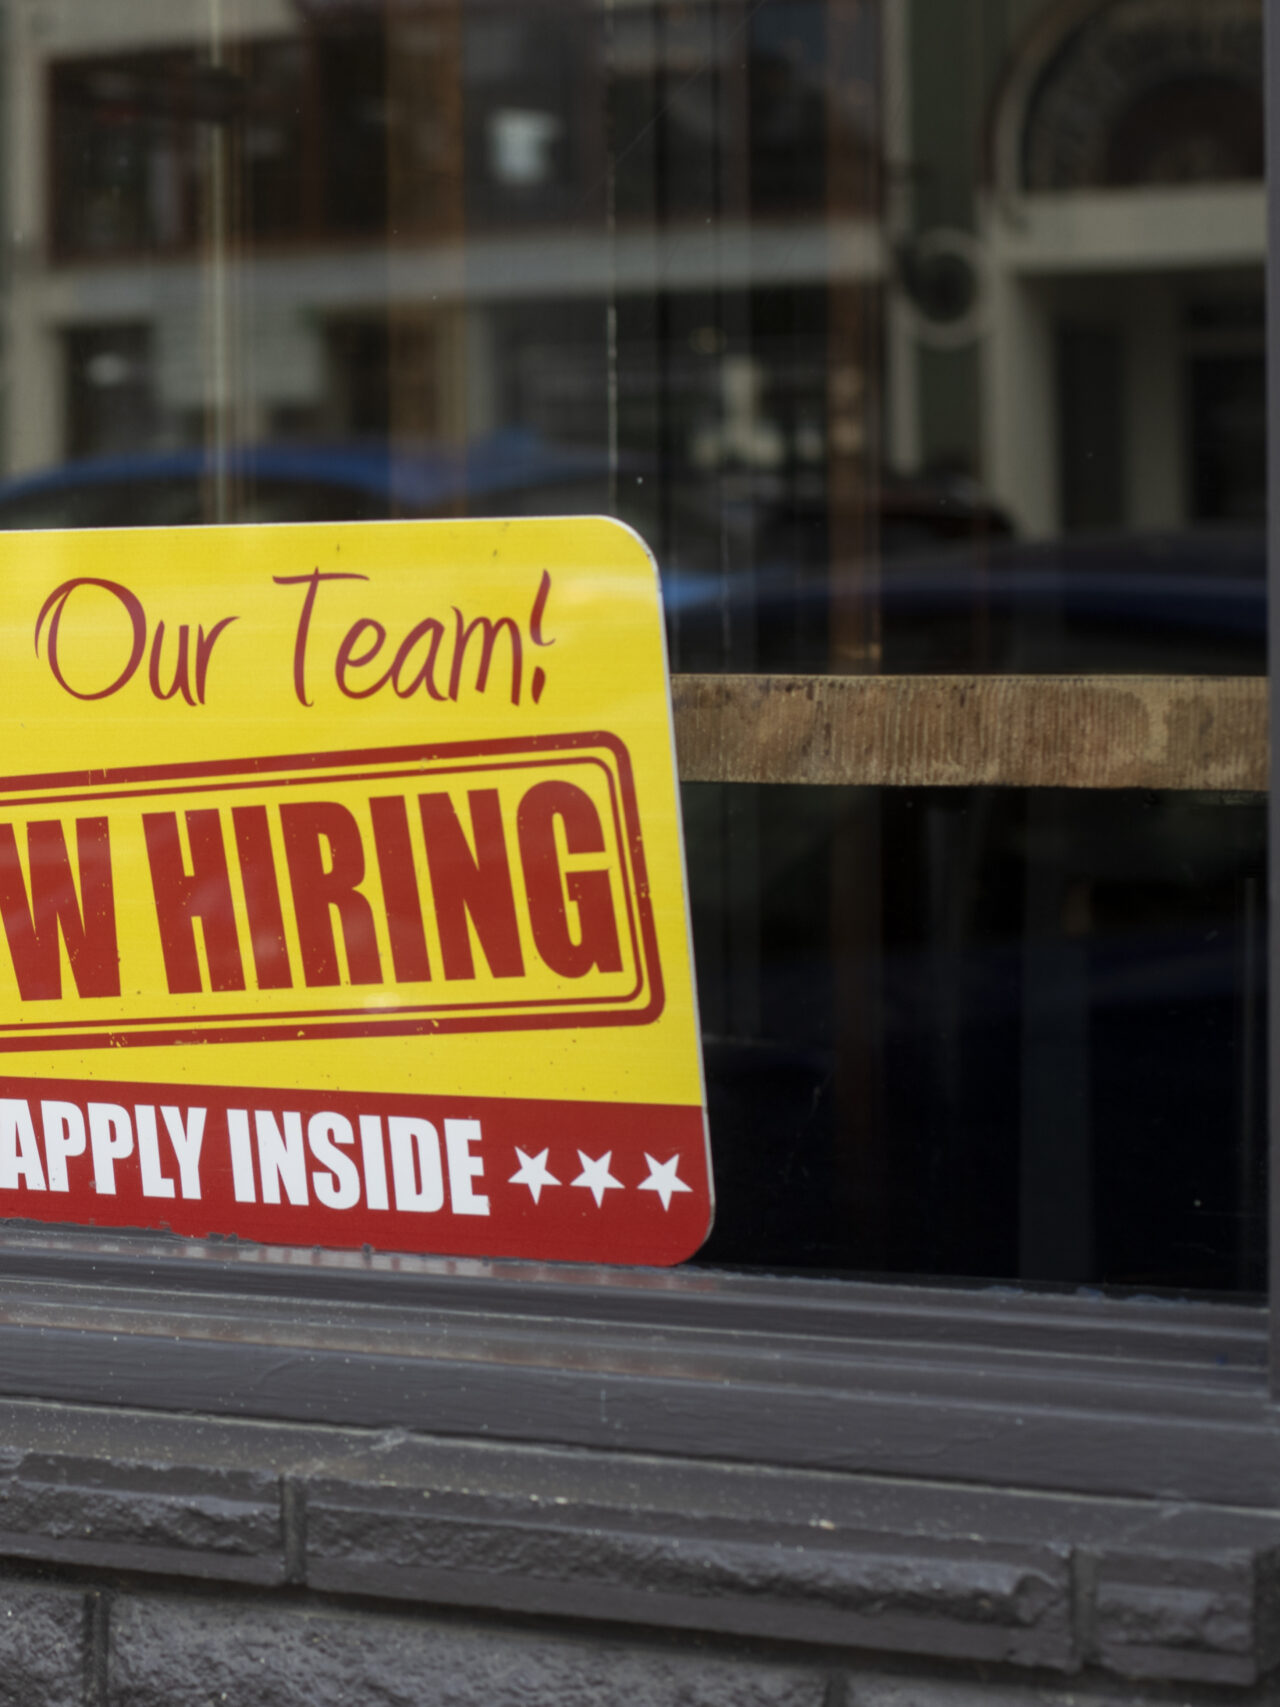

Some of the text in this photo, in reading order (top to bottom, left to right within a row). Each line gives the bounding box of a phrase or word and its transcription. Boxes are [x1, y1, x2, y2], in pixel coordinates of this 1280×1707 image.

[34, 577, 240, 707] Our
[272, 566, 556, 708] Team!
[141, 779, 624, 995] HIRING
[226, 1108, 490, 1216] INSIDE
